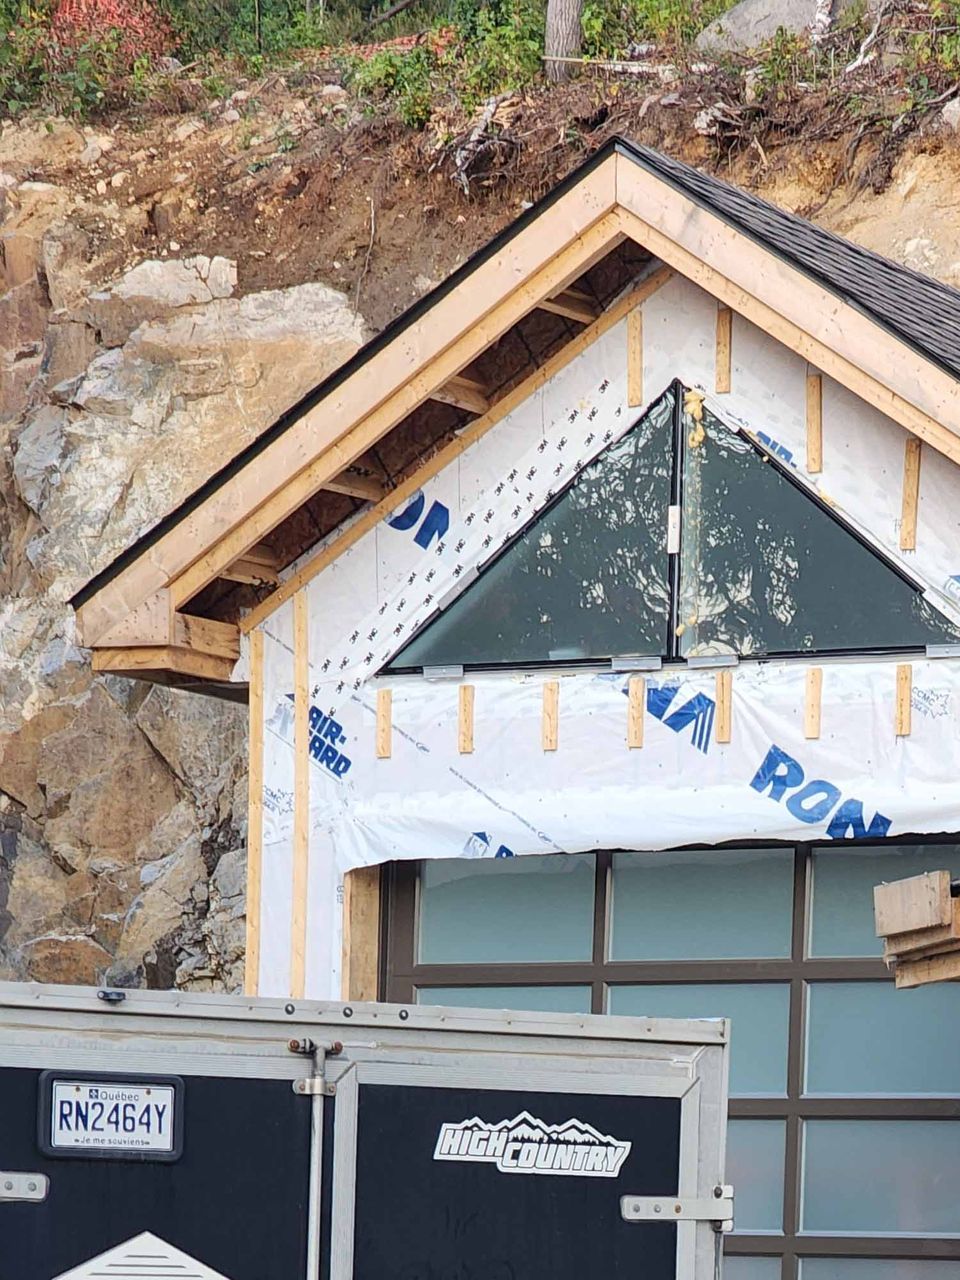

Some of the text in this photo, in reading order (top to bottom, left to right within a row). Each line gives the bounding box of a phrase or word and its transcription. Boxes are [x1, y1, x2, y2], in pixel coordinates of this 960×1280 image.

[309, 728, 353, 780] ARD
[101, 1090, 139, 1102] Québec
[59, 1100, 167, 1135] RN2464Y
[439, 1128, 505, 1157] HIGH
[499, 1141, 627, 1173] COUNTRY
